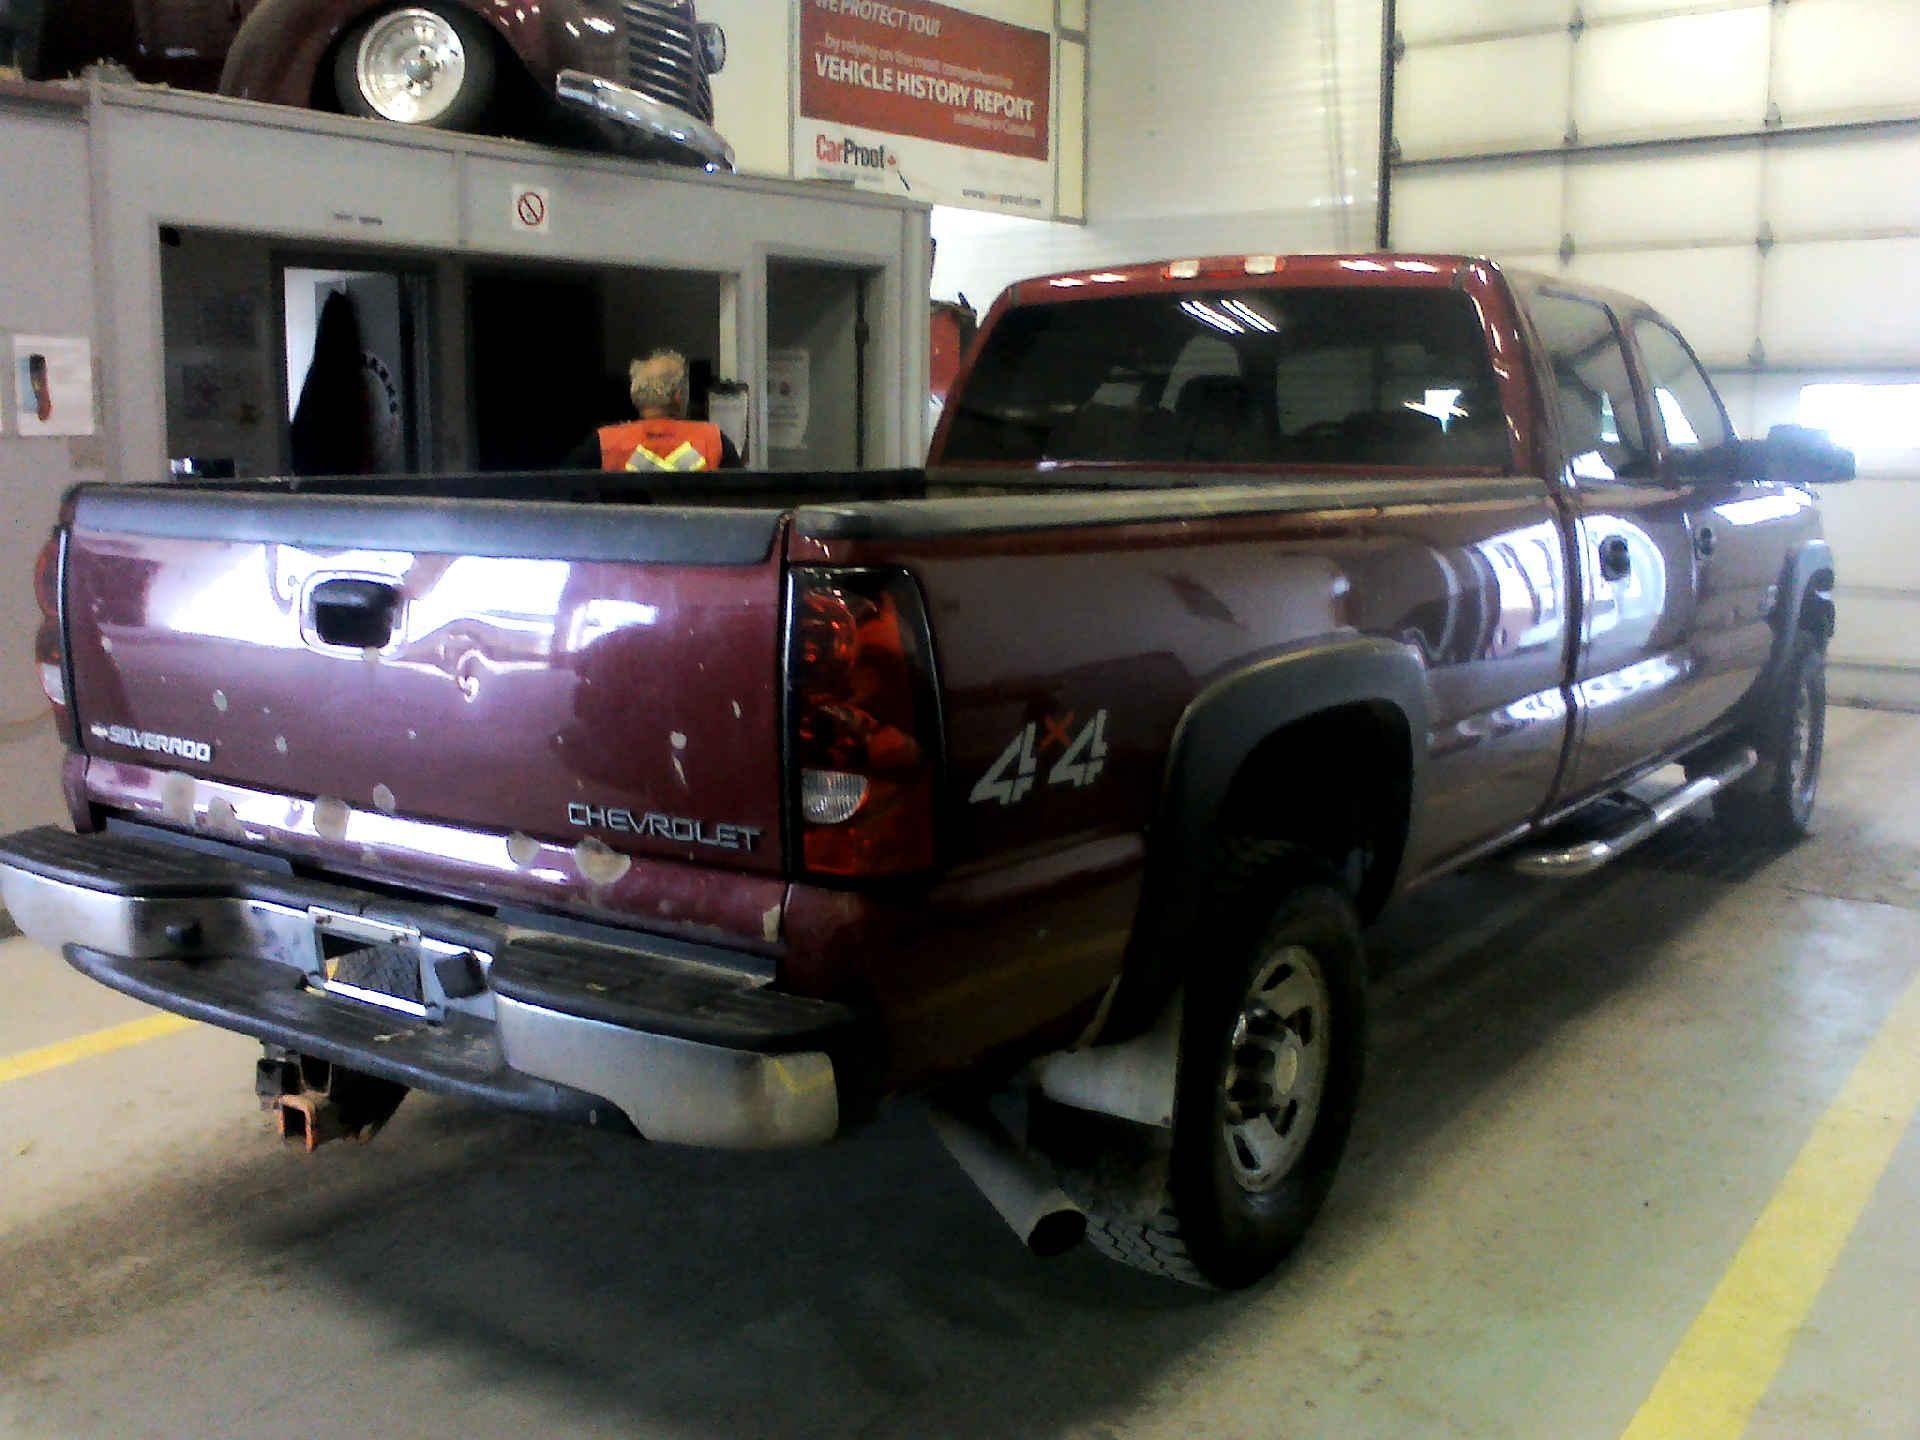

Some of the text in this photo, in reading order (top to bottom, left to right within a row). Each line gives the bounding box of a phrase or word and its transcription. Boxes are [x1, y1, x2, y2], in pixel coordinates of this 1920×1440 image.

[840, 0, 906, 28] PROTECT
[815, 52, 893, 92] VEHICLE
[897, 71, 971, 108] HISTORY
[974, 88, 1034, 121] REPORT
[110, 725, 211, 762] SILVERADO
[568, 801, 761, 851] CHEVROLET
